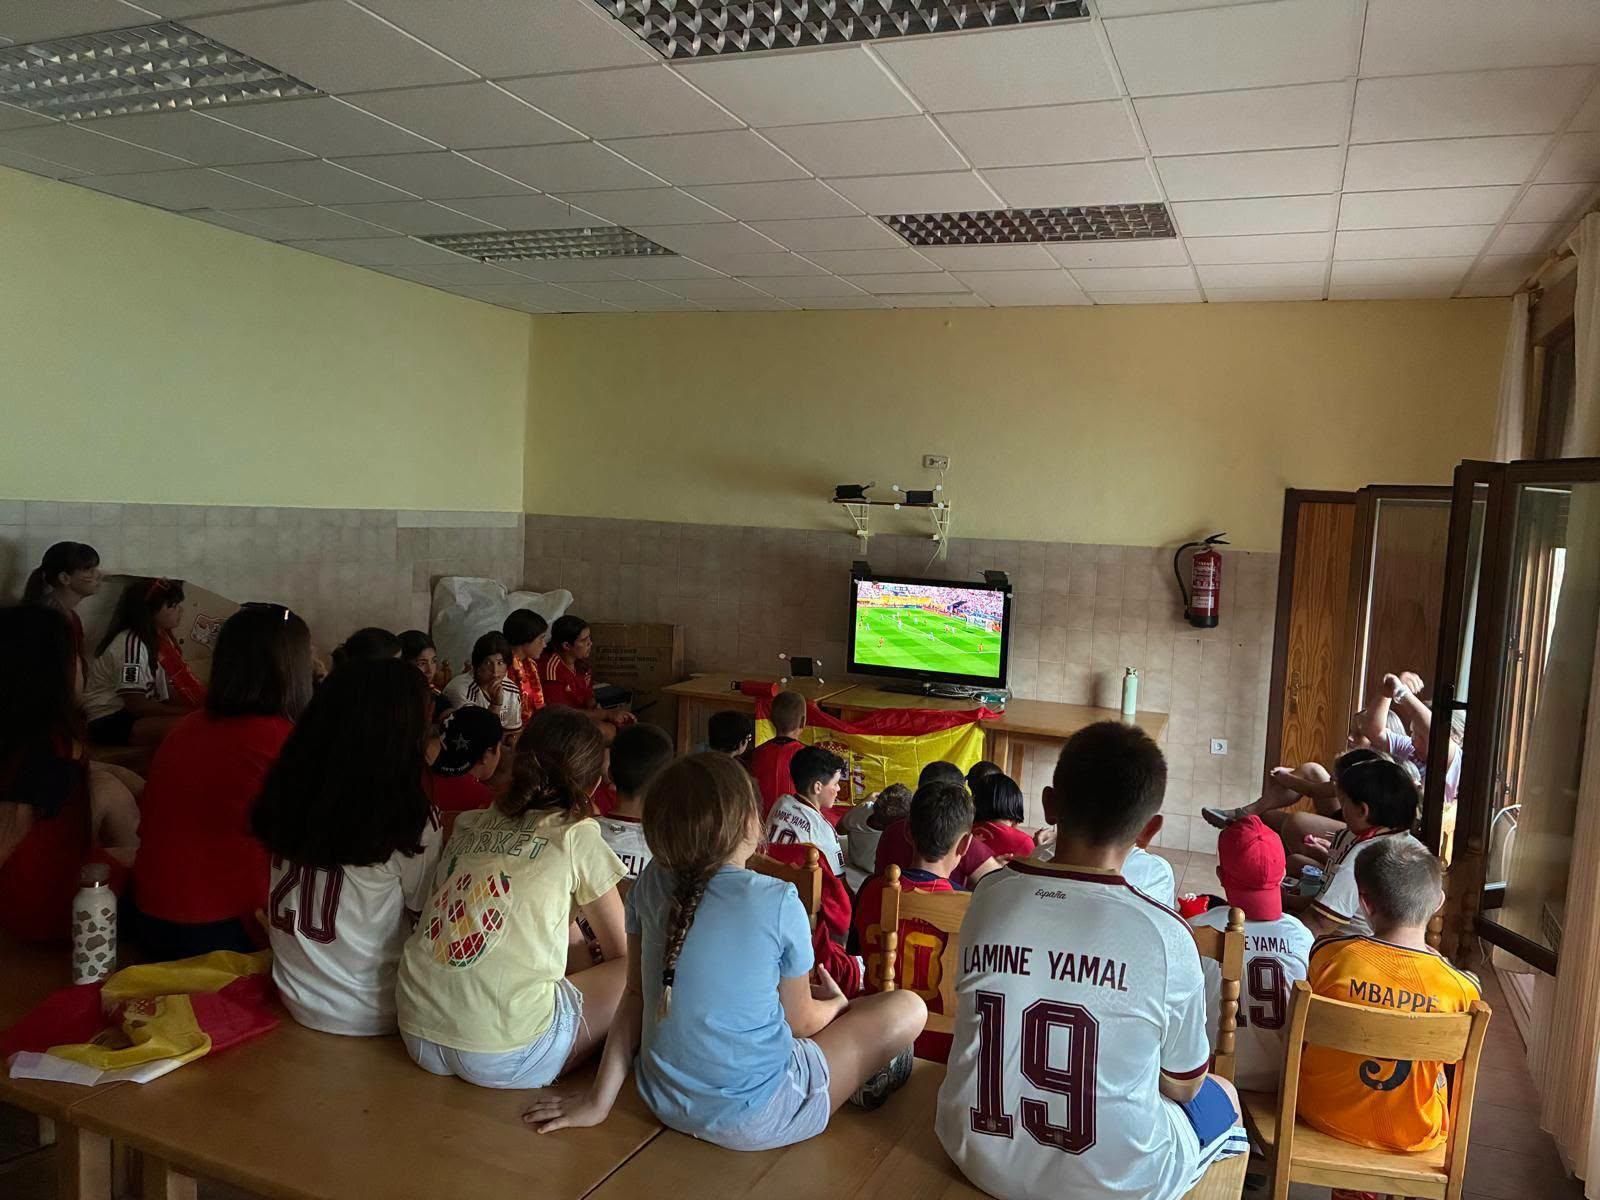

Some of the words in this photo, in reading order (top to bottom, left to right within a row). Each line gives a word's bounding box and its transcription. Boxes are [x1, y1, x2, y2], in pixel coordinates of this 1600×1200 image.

[448, 831, 549, 860] MARKET
[270, 856, 345, 945] 20
[1035, 888, 1067, 900] España
[963, 944, 1033, 976] LAMINE
[1048, 950, 1129, 992] YAMAL
[1252, 936, 1293, 954] YAMAL
[1235, 955, 1286, 1030] 9
[970, 989, 1100, 1156] 19
